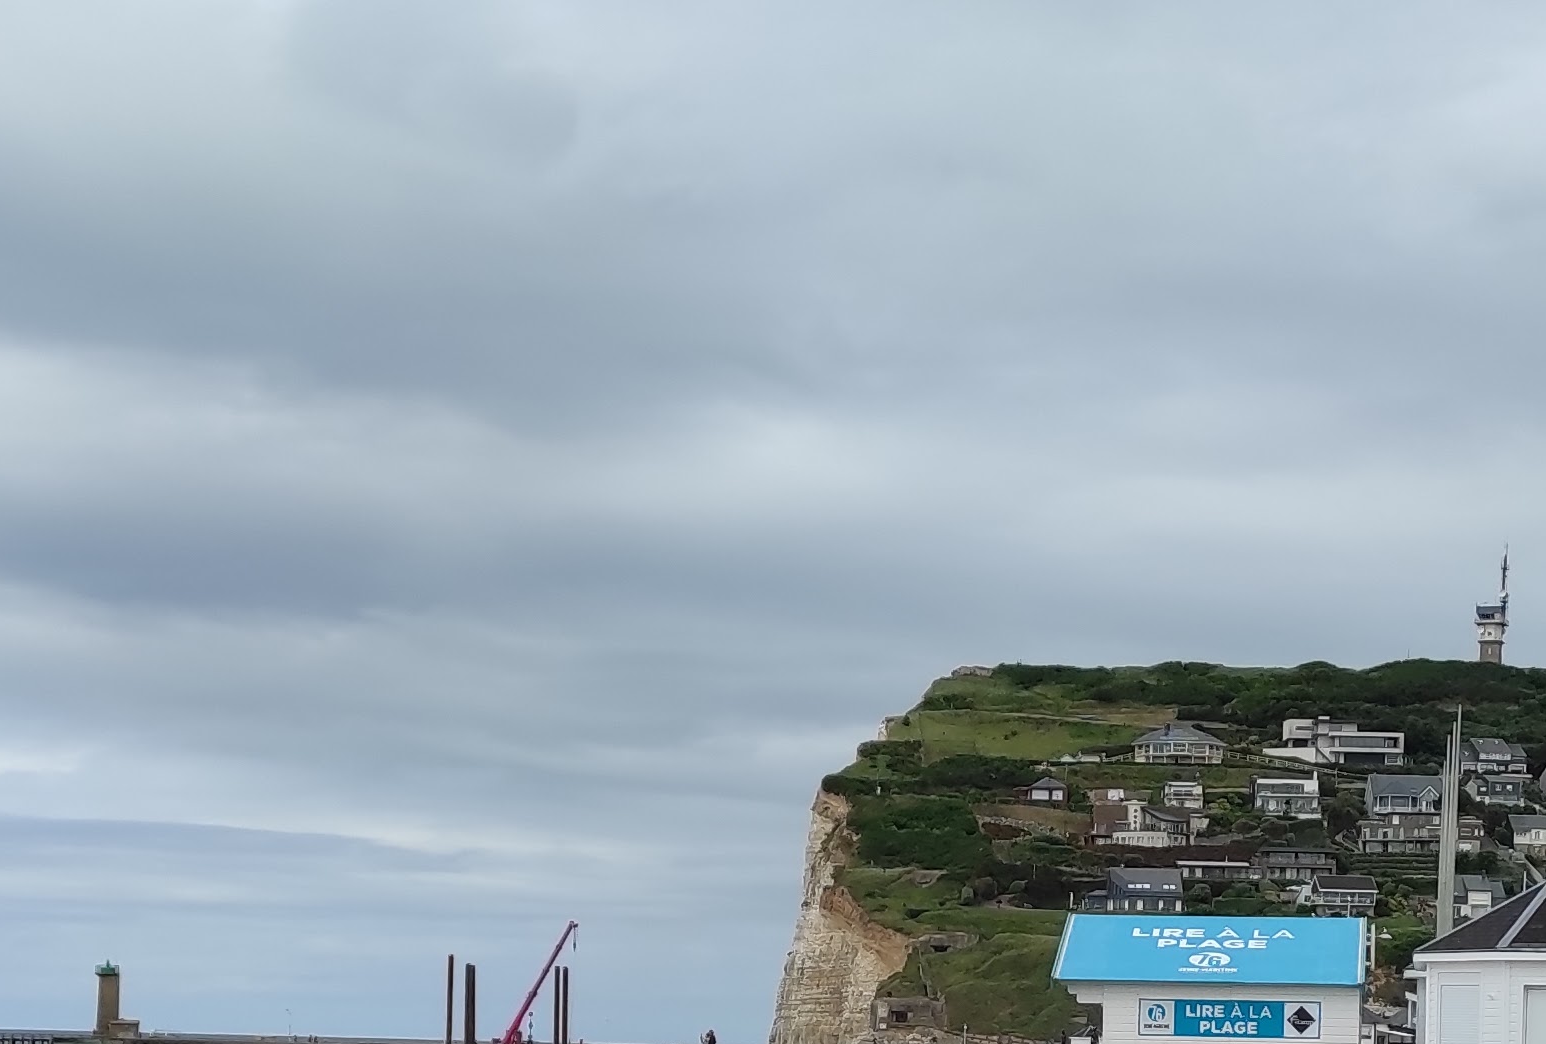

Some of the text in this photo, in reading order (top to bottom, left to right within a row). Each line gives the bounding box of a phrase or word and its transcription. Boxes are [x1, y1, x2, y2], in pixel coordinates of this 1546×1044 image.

[1132, 926, 1295, 939] LIRE À LA
[1157, 939, 1268, 949] PLAGE
[1148, 1005, 1164, 1021] 76
[1185, 1002, 1272, 1018] LIRE À LA
[1199, 1020, 1258, 1034] PLAGE
